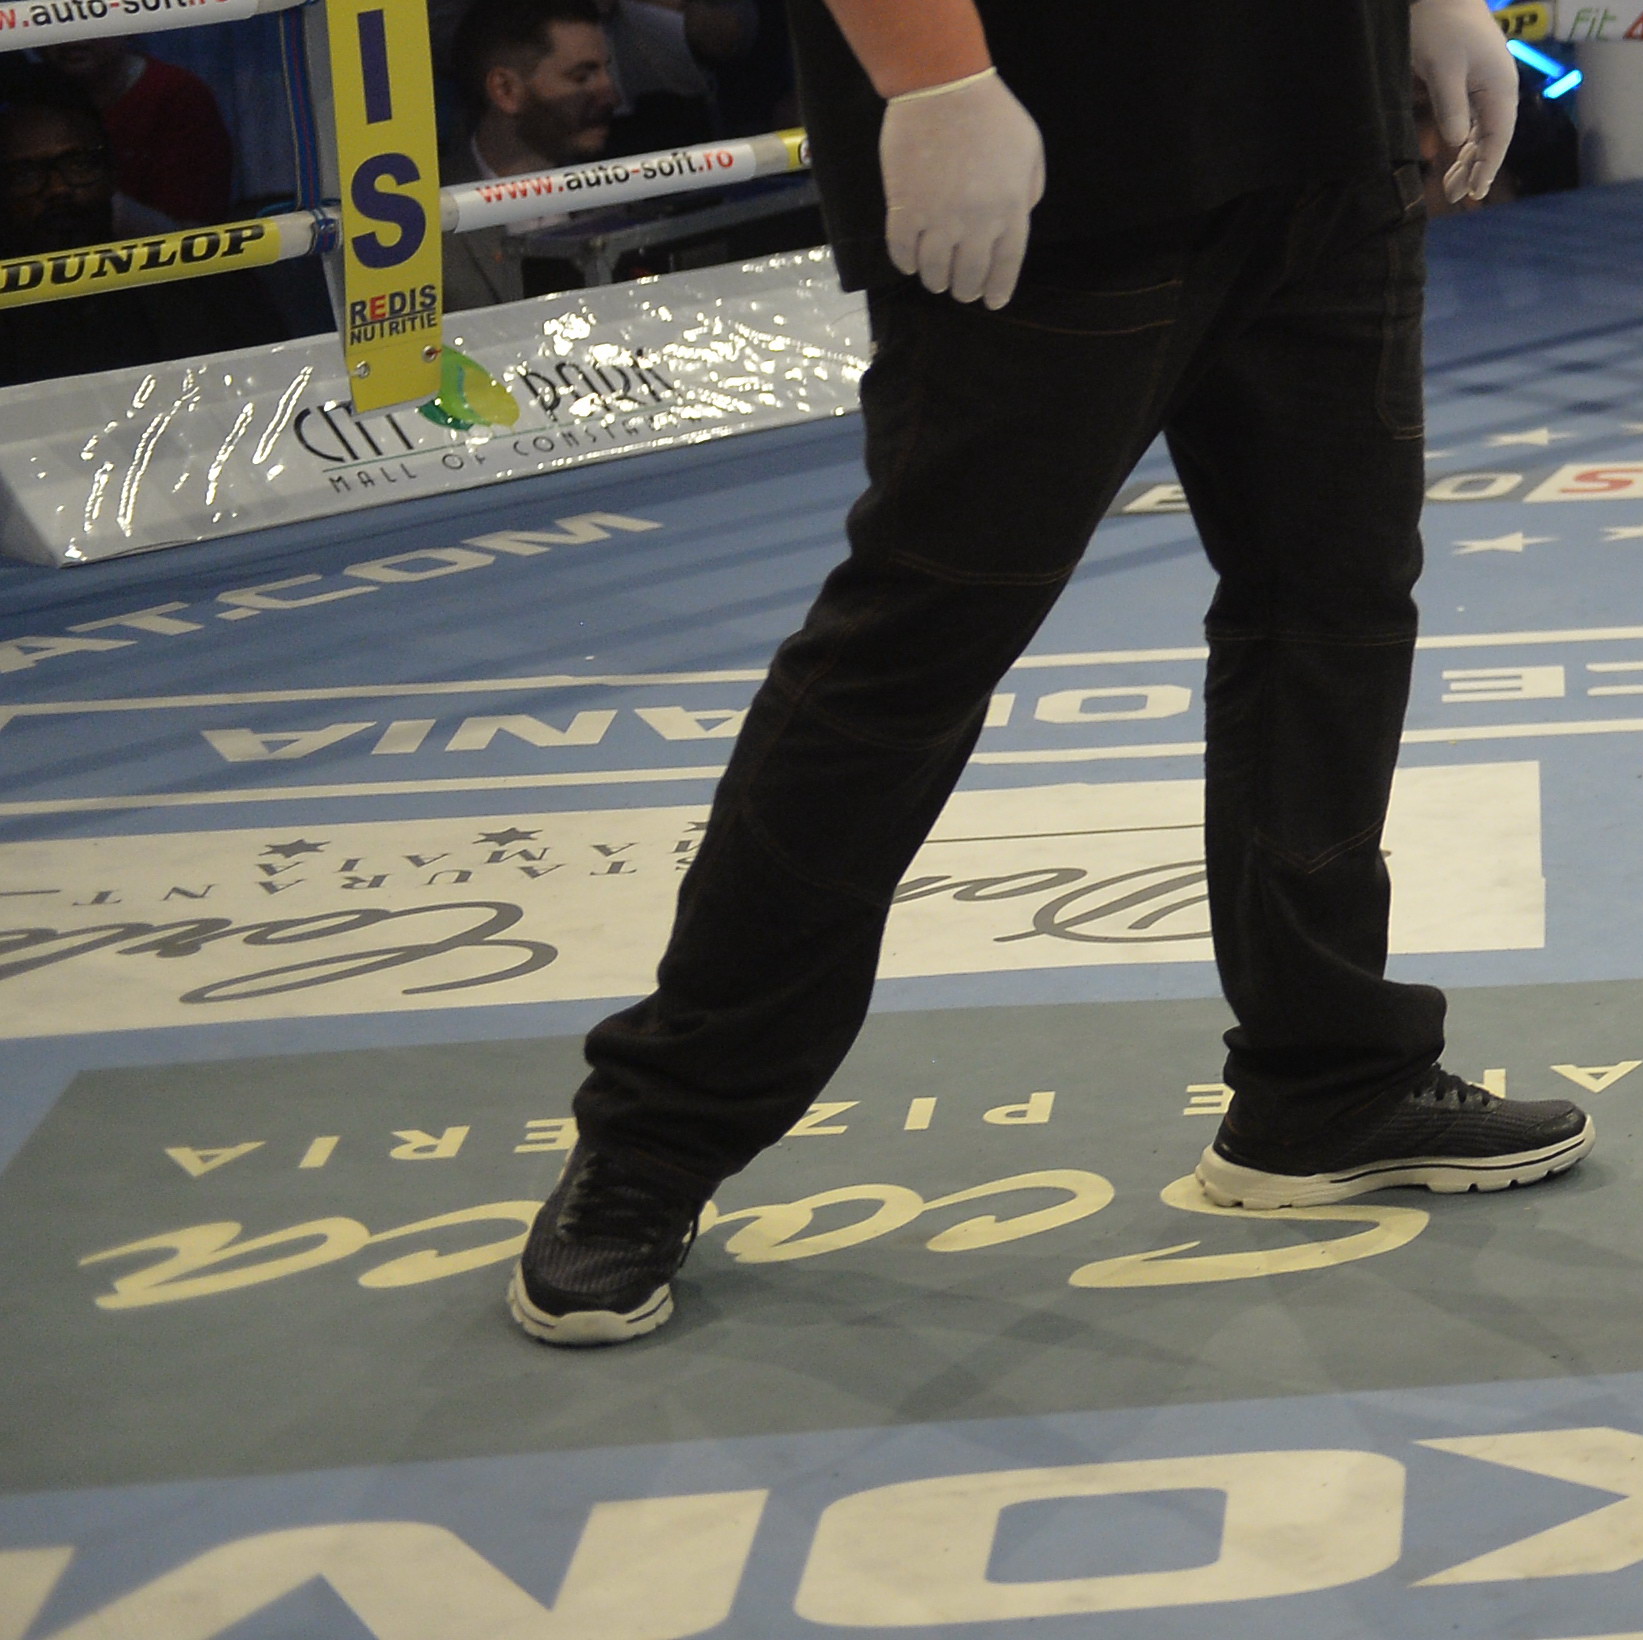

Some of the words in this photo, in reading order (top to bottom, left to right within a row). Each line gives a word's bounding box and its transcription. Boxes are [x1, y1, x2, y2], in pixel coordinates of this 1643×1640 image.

[476, 149, 735, 203] www.auto-soft.ro
[0, 224, 265, 296] DUNLOP
[349, 284, 438, 327] REDIS
[349, 311, 438, 346] NUTRITIE
[328, 463, 418, 494] MALL
[164, 1089, 1057, 1179] PIZERIA
